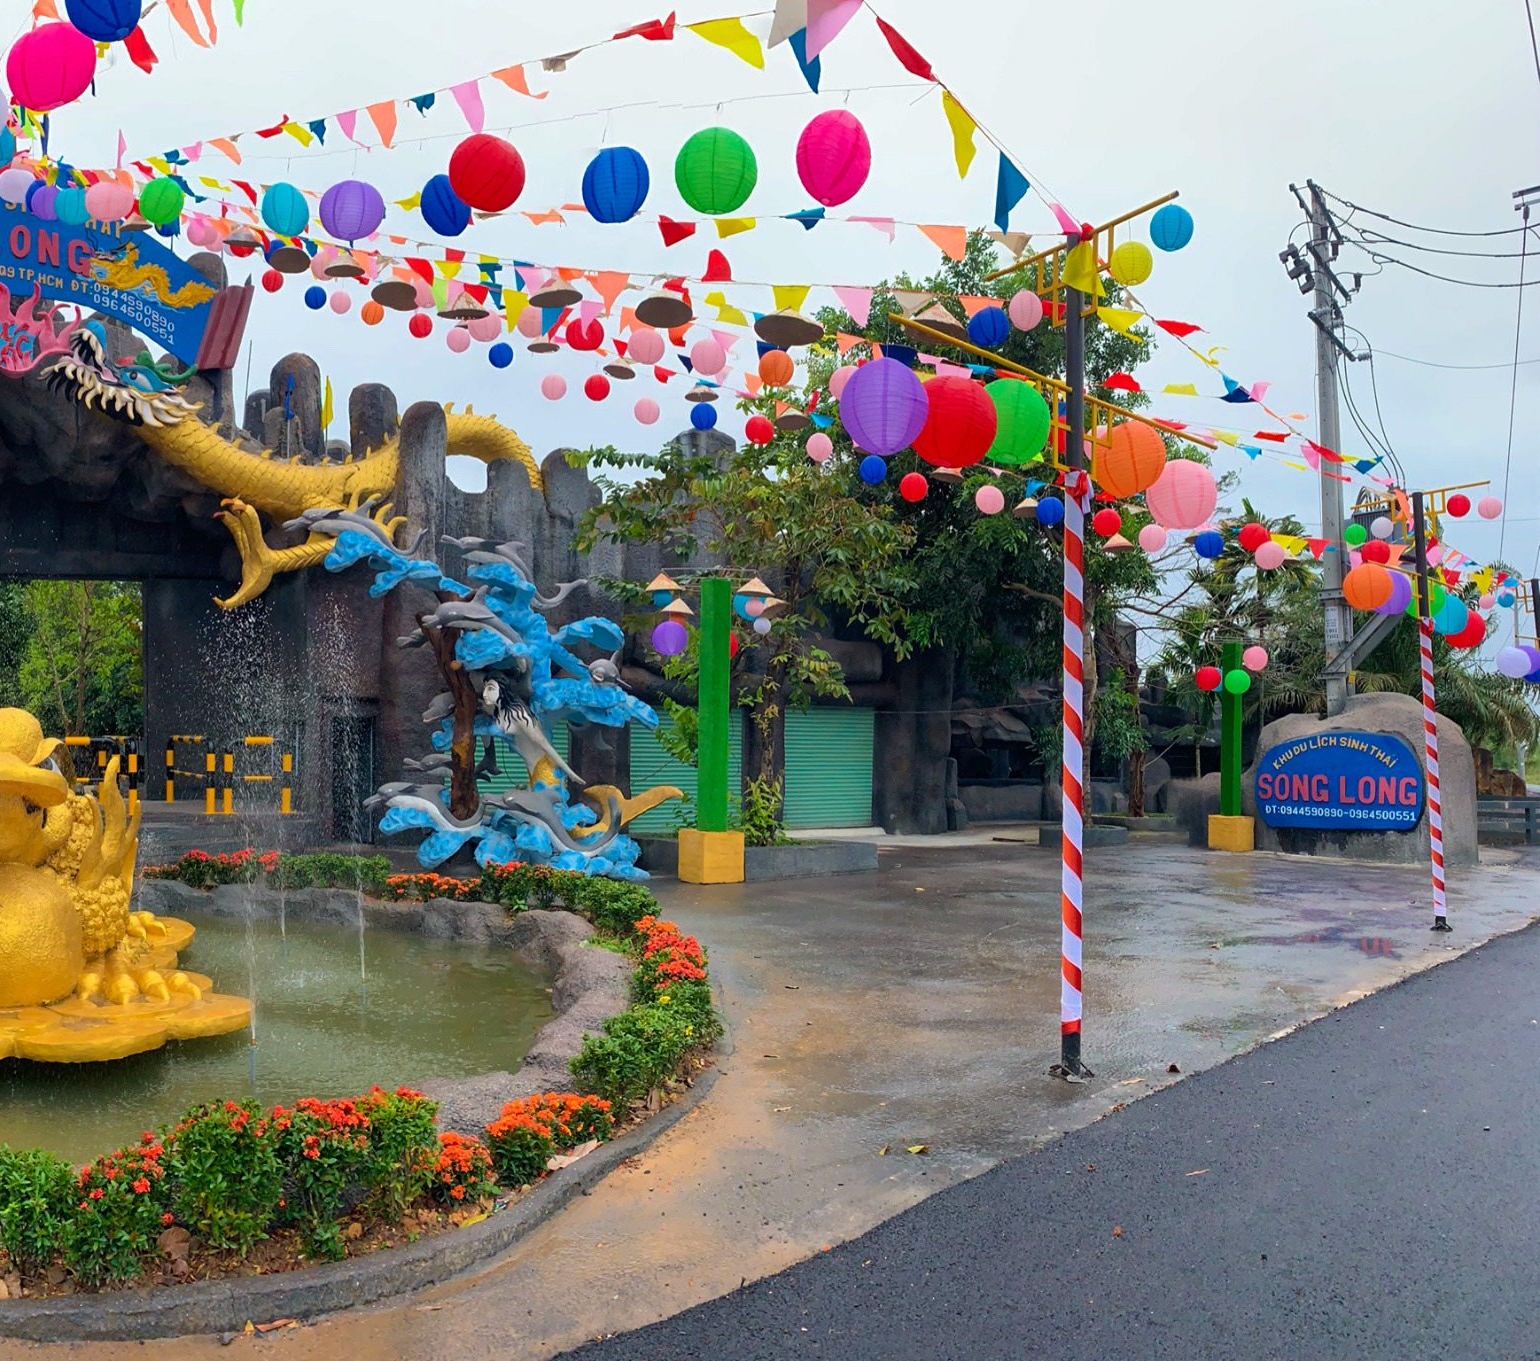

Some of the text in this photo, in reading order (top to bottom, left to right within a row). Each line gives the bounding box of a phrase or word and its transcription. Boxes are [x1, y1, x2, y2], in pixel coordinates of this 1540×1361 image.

[93, 293, 176, 346] 0964500551
[1272, 749, 1294, 771] KHU
[1292, 742, 1308, 756] DU
[1258, 773, 1418, 806] SONG LONG
